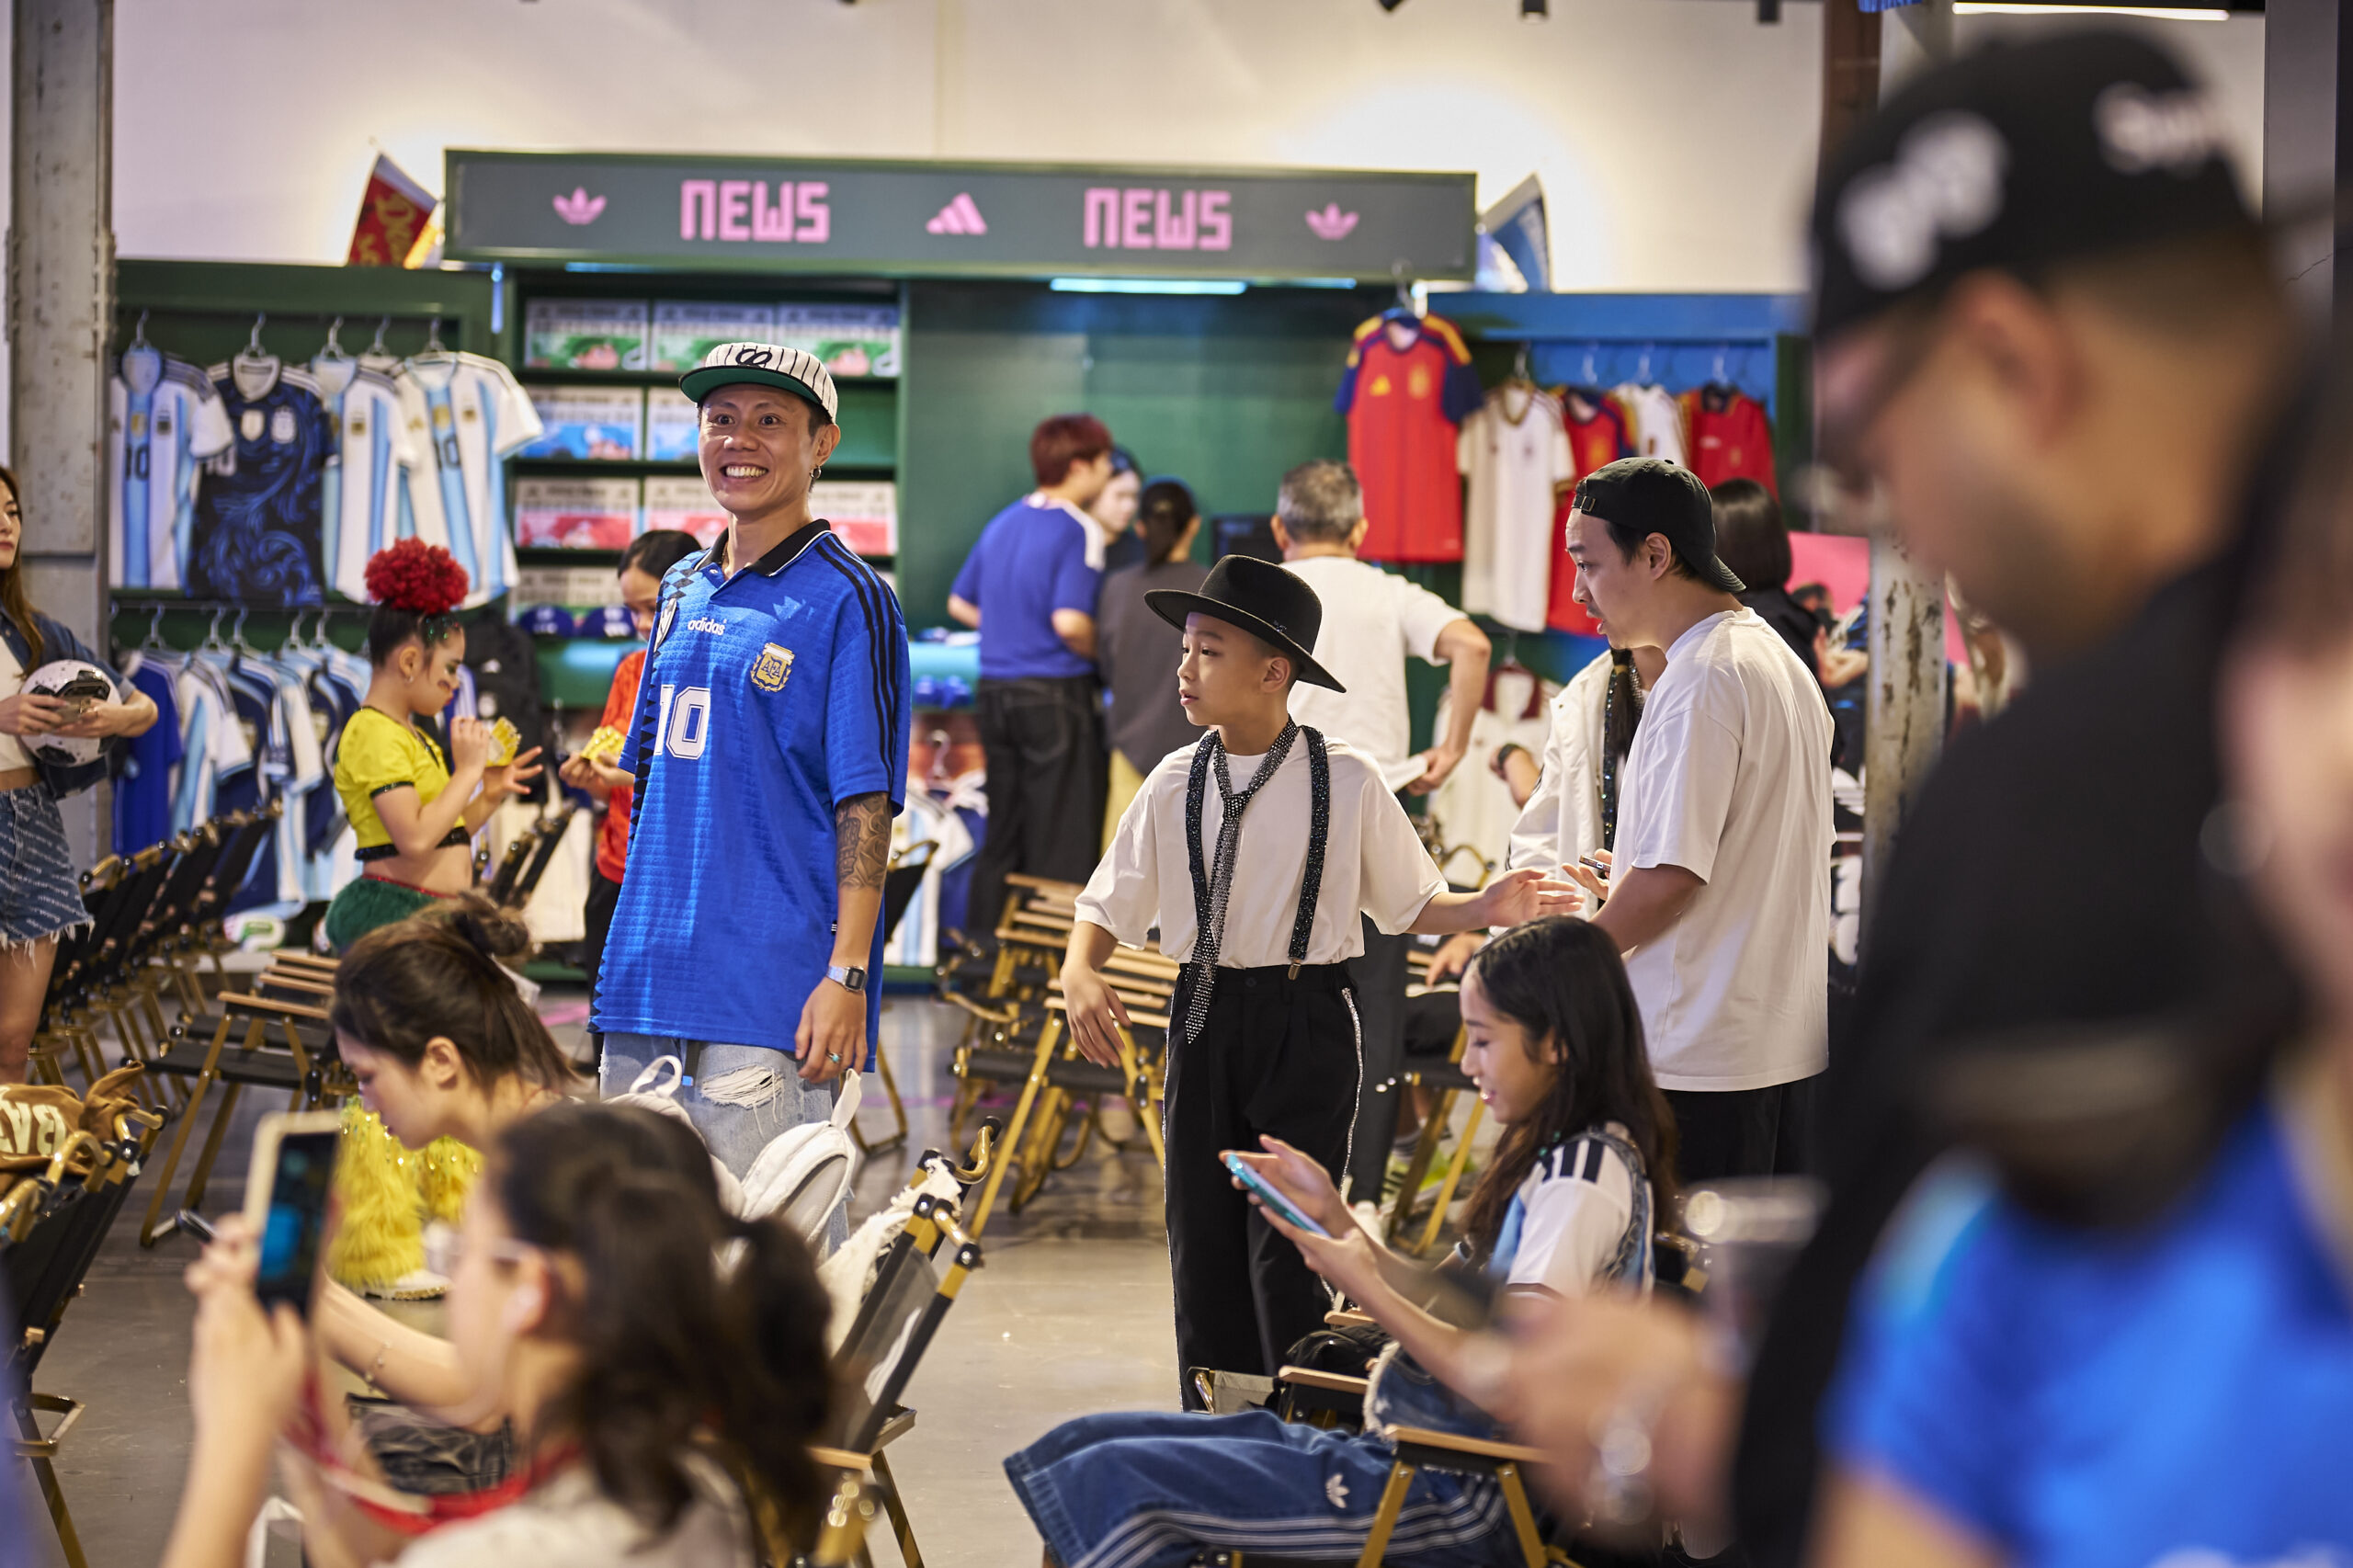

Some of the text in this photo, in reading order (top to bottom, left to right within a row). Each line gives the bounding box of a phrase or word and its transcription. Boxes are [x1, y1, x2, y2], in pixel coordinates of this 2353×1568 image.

[680, 179, 1233, 251] NEWS NEWS
[124, 443, 150, 482] 10
[434, 434, 461, 472] 10
[688, 617, 725, 636] adidas
[654, 684, 711, 760] 10
